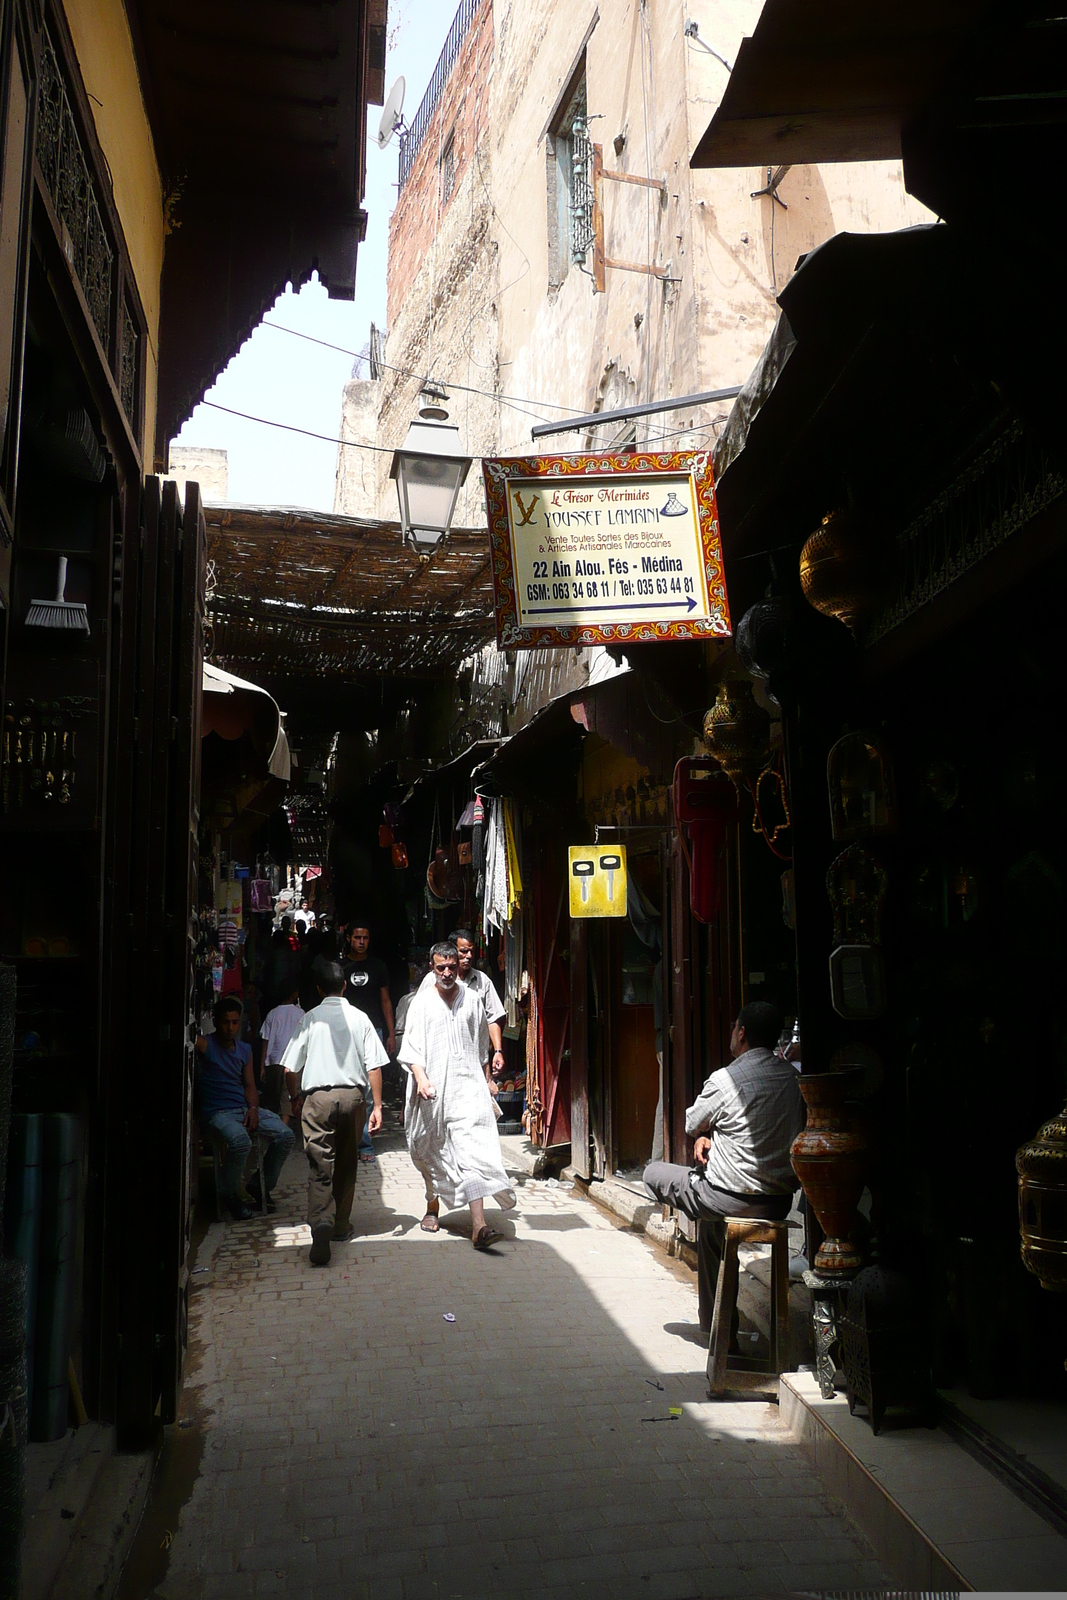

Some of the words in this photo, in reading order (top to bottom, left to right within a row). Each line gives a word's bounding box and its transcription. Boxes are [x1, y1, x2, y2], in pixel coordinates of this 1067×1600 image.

[551, 490, 562, 507] Le
[563, 490, 594, 504] Trésor
[597, 488, 650, 502] Merinides
[543, 510, 602, 528] YOUSSEF
[608, 507, 660, 525] LAMRINI
[538, 544, 545, 553] &
[547, 543, 577, 553] Articles
[579, 541, 622, 551] Artisanales
[624, 540, 671, 549] Marocaines
[544, 535, 568, 544] Vente
[570, 534, 595, 543] Toutes
[597, 533, 621, 542] Sortes
[623, 532, 638, 541] des
[641, 531, 664, 540] Bijoux
[532, 561, 548, 578] 22
[552, 560, 571, 578] Ain
[608, 557, 629, 575] Fés
[641, 556, 683, 573] Médina
[526, 583, 551, 601] GSM:
[552, 582, 570, 599] 063
[572, 581, 584, 599] 34
[586, 581, 598, 598] 68
[600, 580, 610, 597] 11
[619, 579, 635, 596] Tel:
[637, 578, 654, 595] 035
[656, 577, 668, 594] 63
[670, 577, 682, 594] 44
[684, 576, 694, 593] 81
